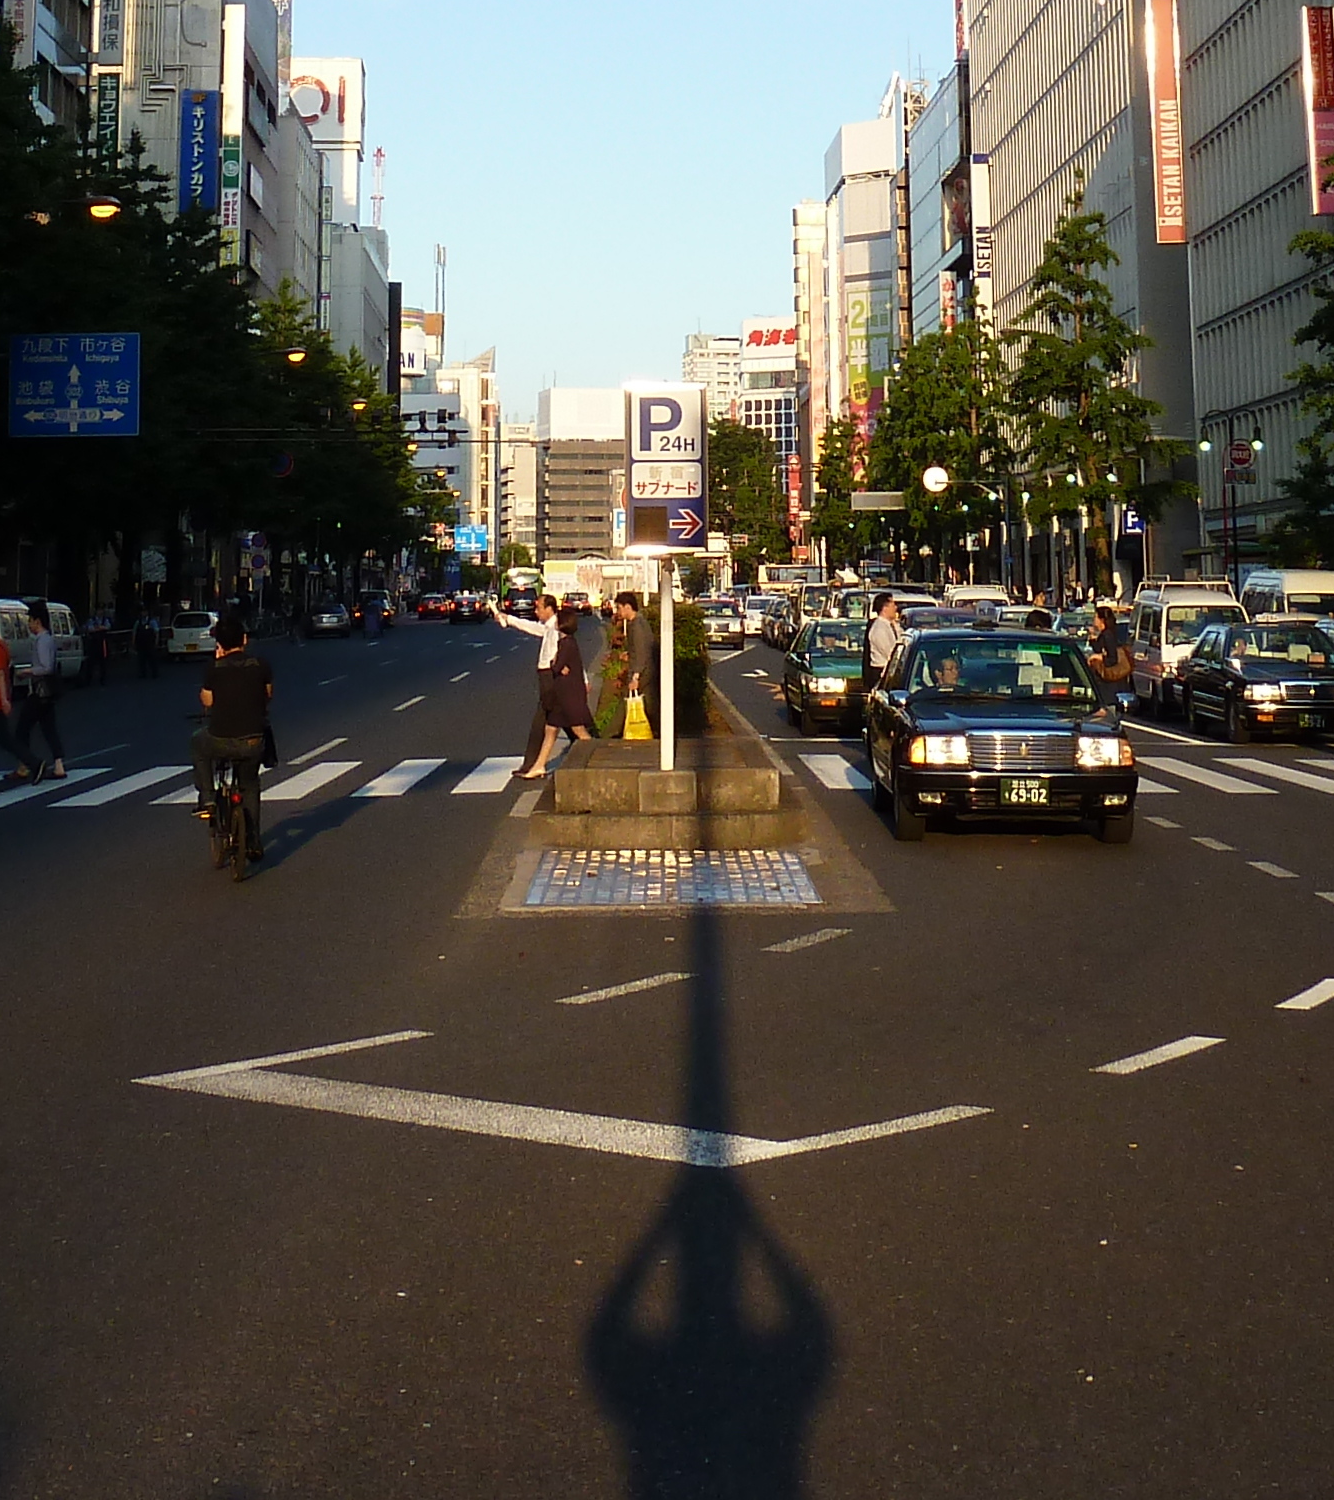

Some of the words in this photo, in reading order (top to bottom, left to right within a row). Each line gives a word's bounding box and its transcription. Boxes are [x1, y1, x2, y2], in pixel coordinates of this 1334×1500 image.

[1158, 99, 1180, 158] KAIKAN
[22, 337, 70, 354] 九段下
[17, 379, 55, 396] 池袋
[94, 379, 132, 395] 渋谷
[639, 396, 683, 452] P
[659, 436, 696, 452] 24H
[634, 479, 699, 496] サブナード
[1010, 788, 1047, 803] 69-02
